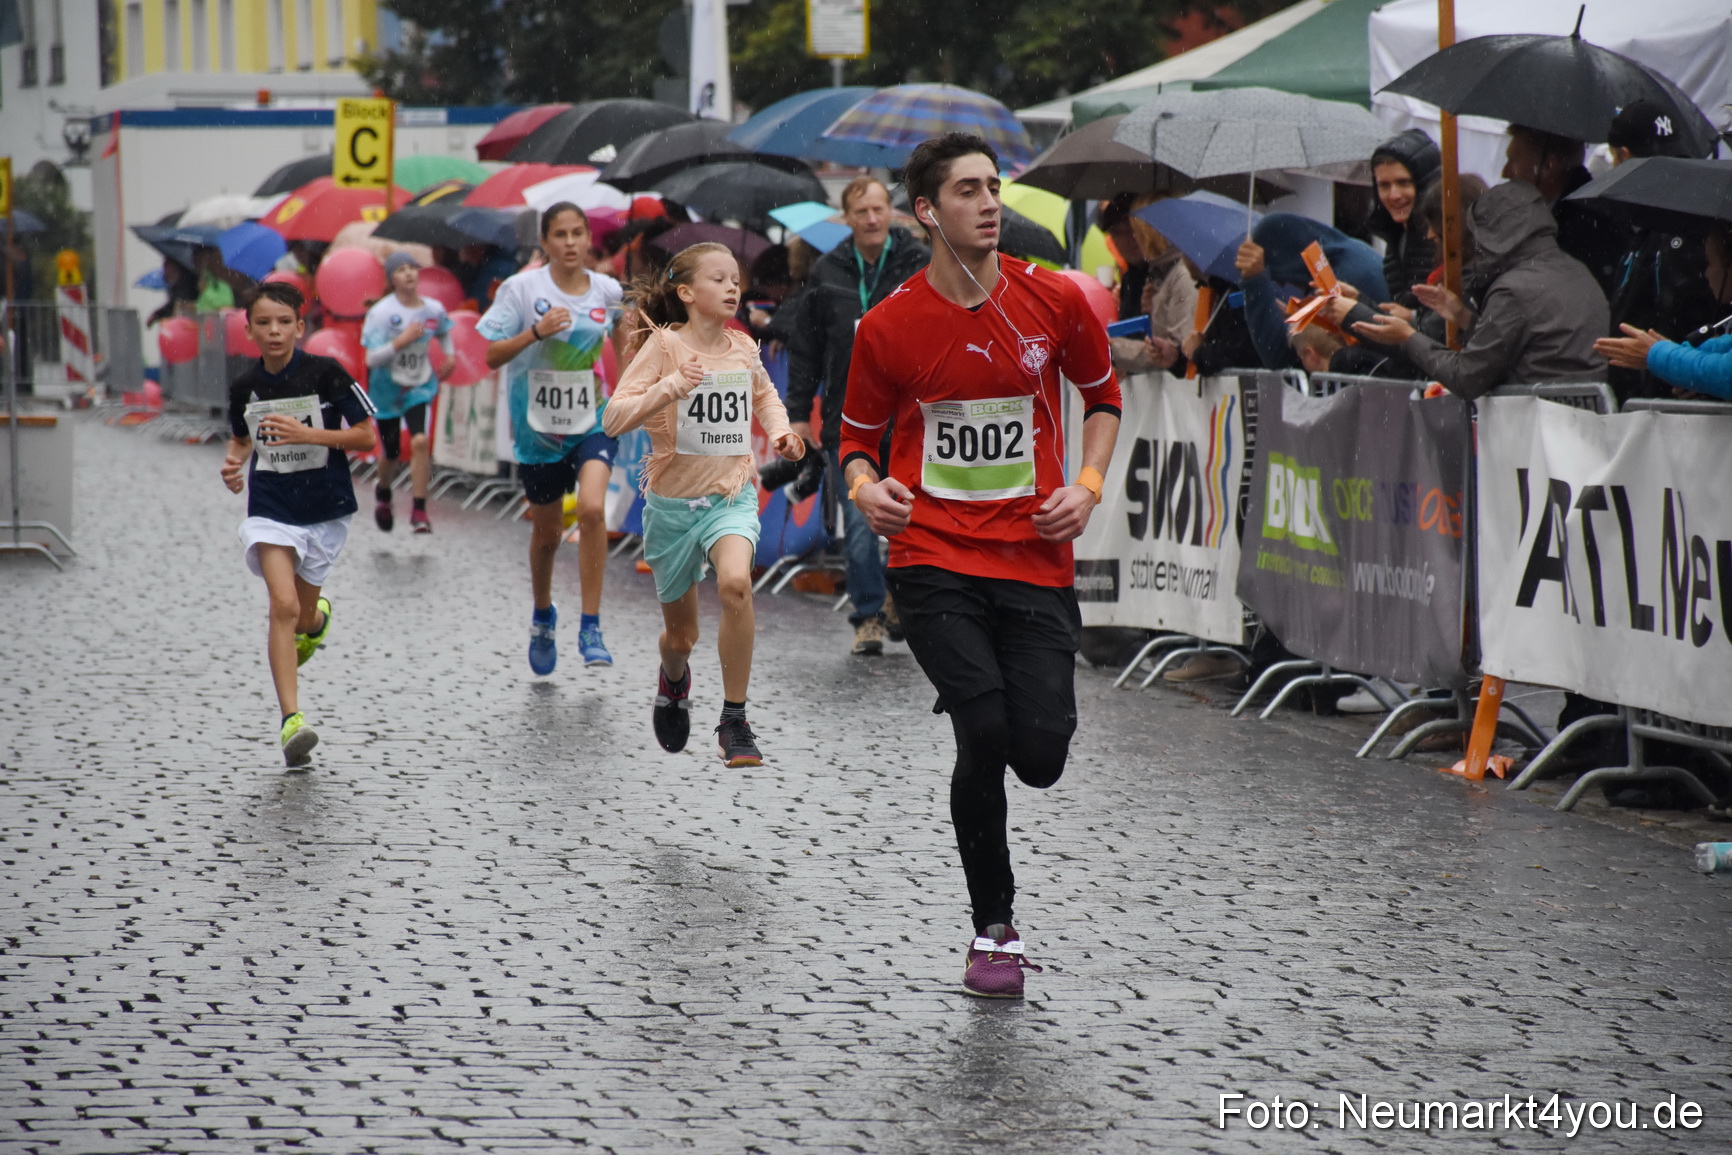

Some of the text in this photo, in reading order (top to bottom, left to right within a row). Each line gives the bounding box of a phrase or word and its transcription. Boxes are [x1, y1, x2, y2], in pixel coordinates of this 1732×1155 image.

[350, 126, 378, 169] C
[717, 372, 748, 384] BOCK
[535, 386, 589, 410] 4014
[687, 390, 748, 424] 4031
[970, 400, 1024, 416] BOCK
[551, 415, 572, 426] Sara
[700, 431, 743, 444] Theresa
[936, 420, 1024, 462] 5002
[270, 451, 307, 464] Marion
